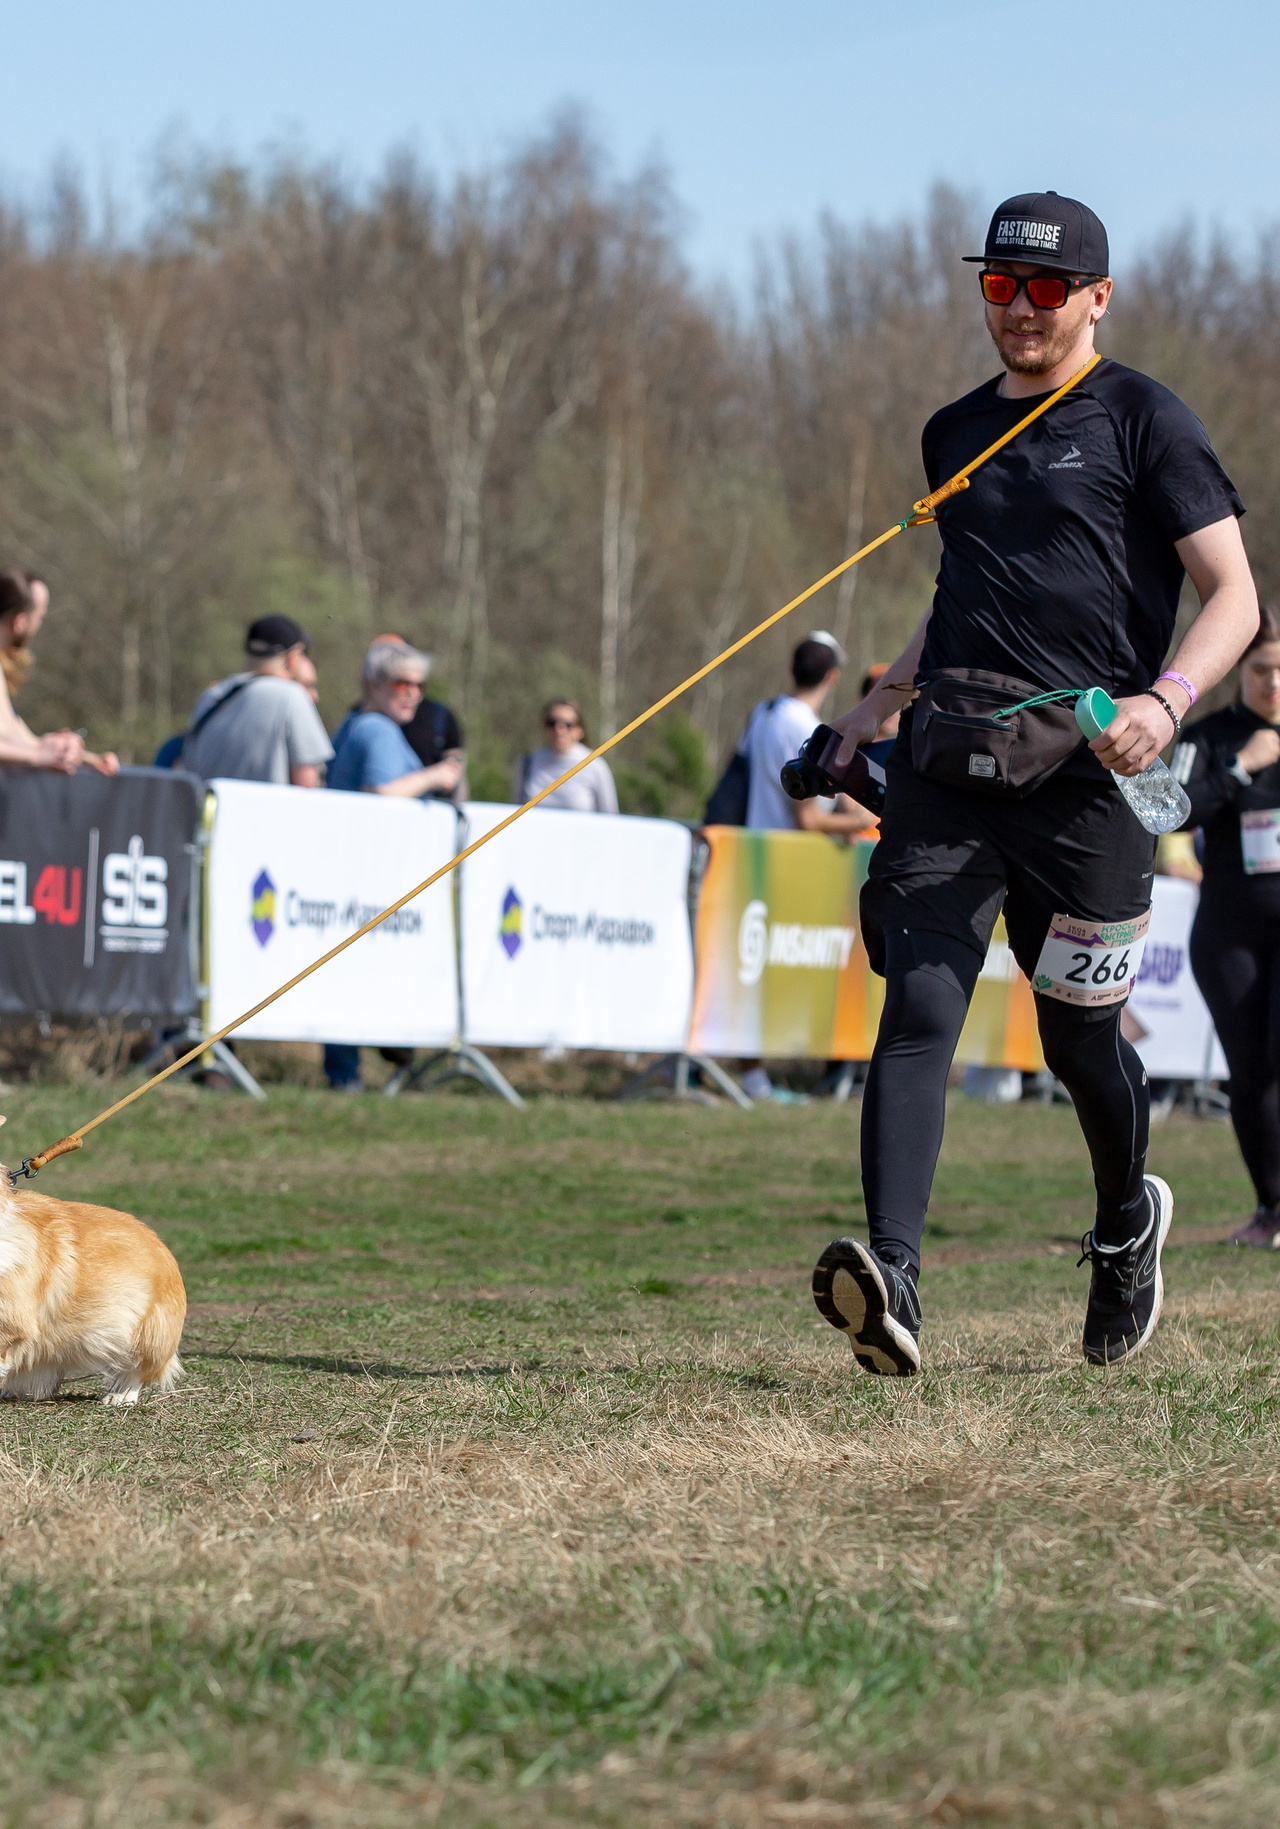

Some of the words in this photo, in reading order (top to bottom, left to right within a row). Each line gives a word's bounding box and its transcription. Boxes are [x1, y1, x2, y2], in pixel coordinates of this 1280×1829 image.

[997, 220, 1061, 242] FASTHOUSE
[1048, 461, 1085, 469] DEMIX
[1064, 948, 1131, 985] 266
